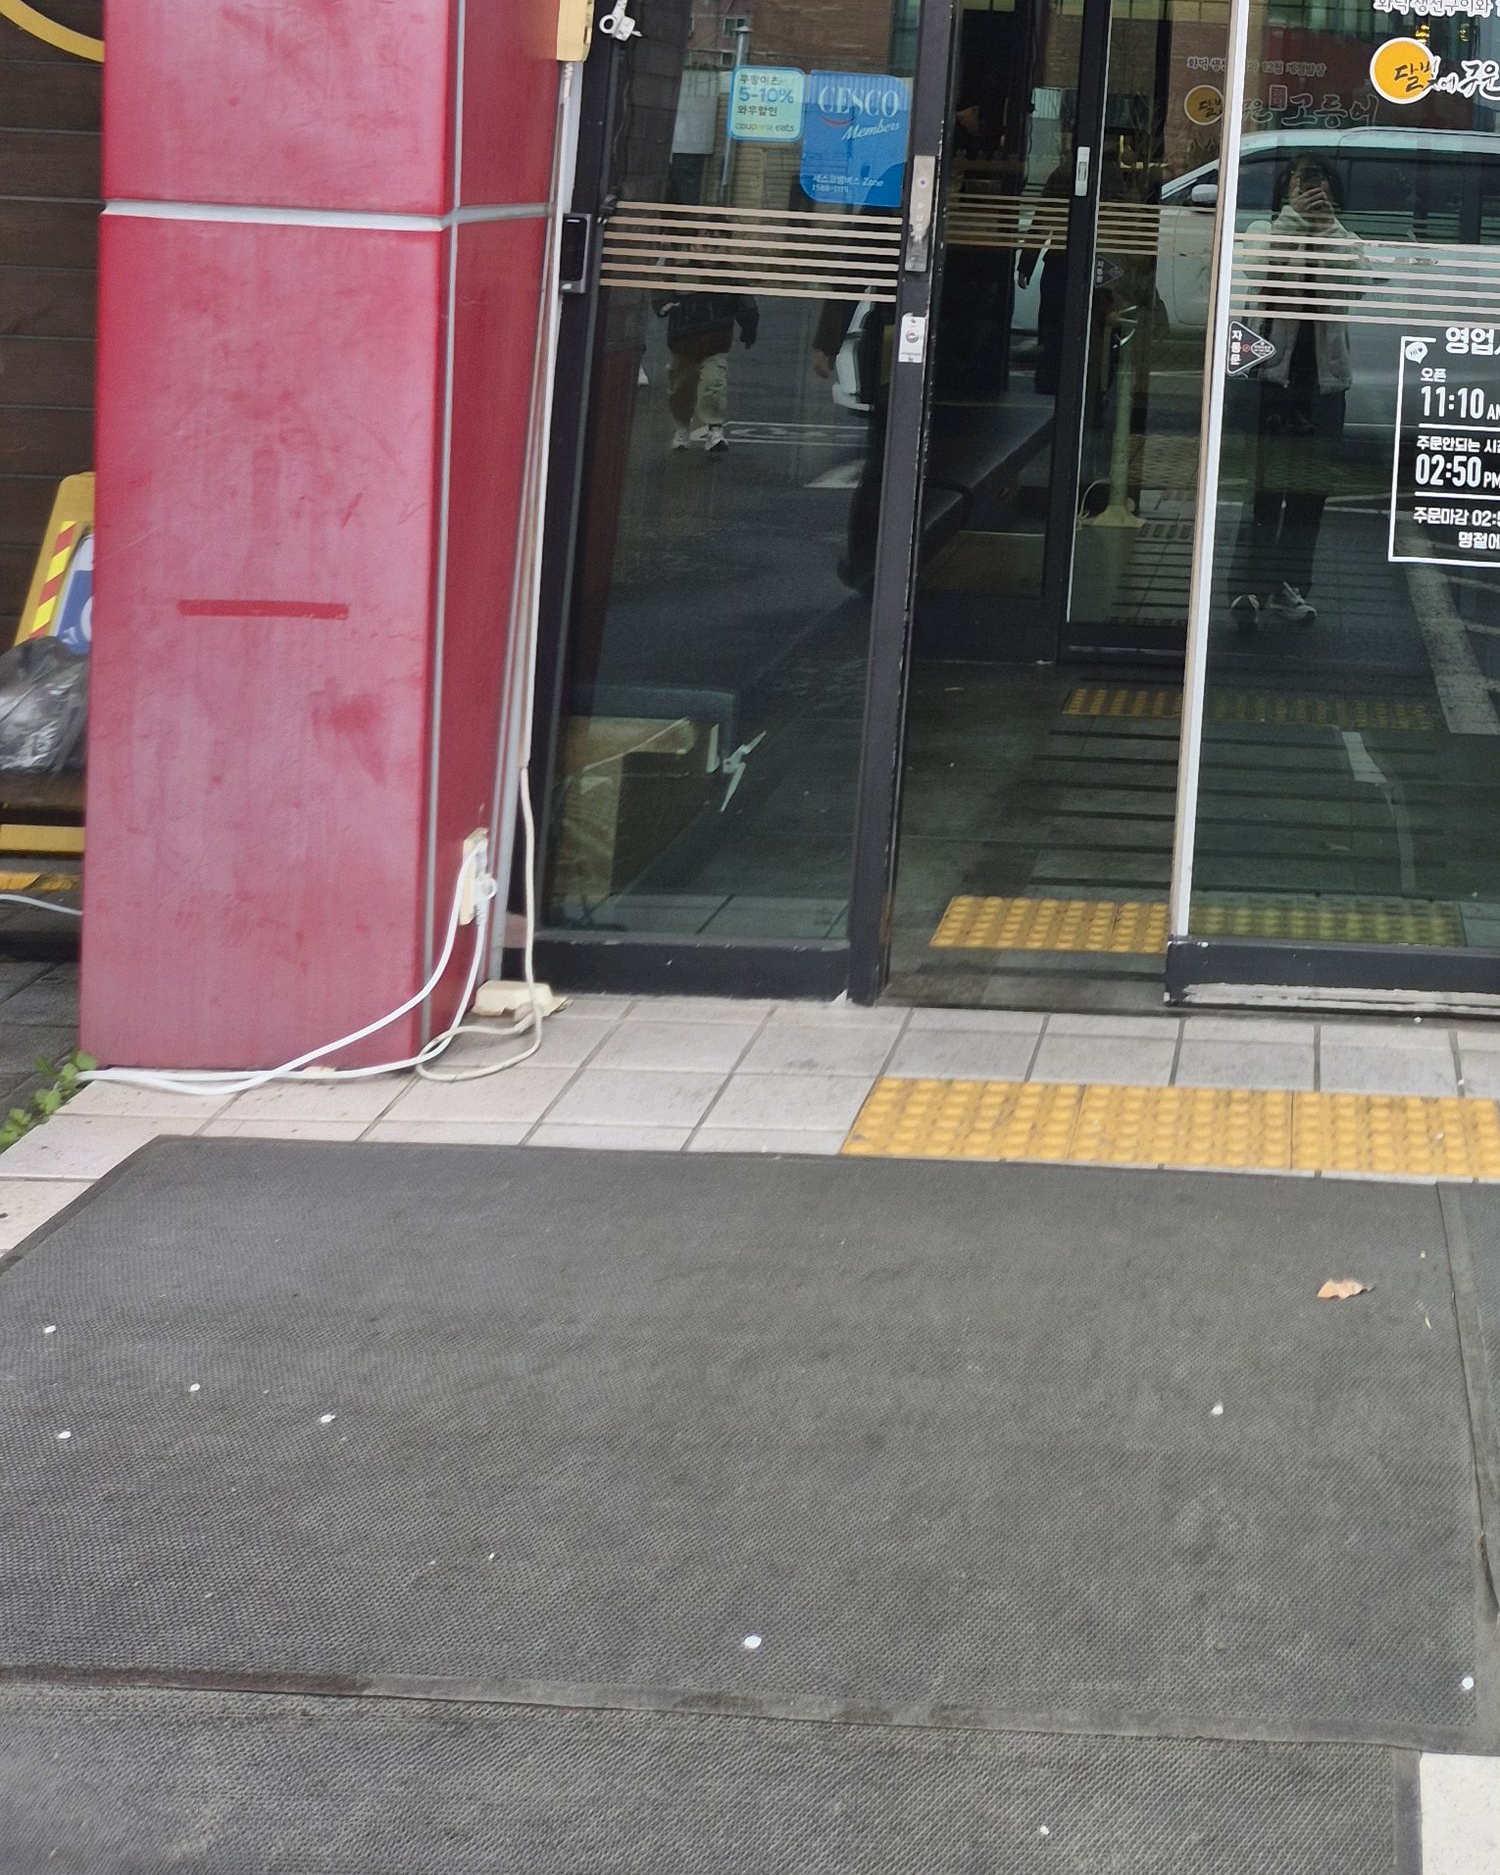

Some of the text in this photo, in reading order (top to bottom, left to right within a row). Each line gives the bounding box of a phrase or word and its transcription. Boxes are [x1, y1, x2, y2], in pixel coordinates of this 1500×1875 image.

[739, 87, 794, 103] 5-10%
[818, 86, 899, 117] CESCO
[842, 118, 900, 141] Members
[1230, 329, 1243, 365] 자동문
[1420, 368, 1446, 383] 오픈
[1416, 435, 1480, 453] 주문안되는
[1413, 507, 1468, 526] 주문마감
